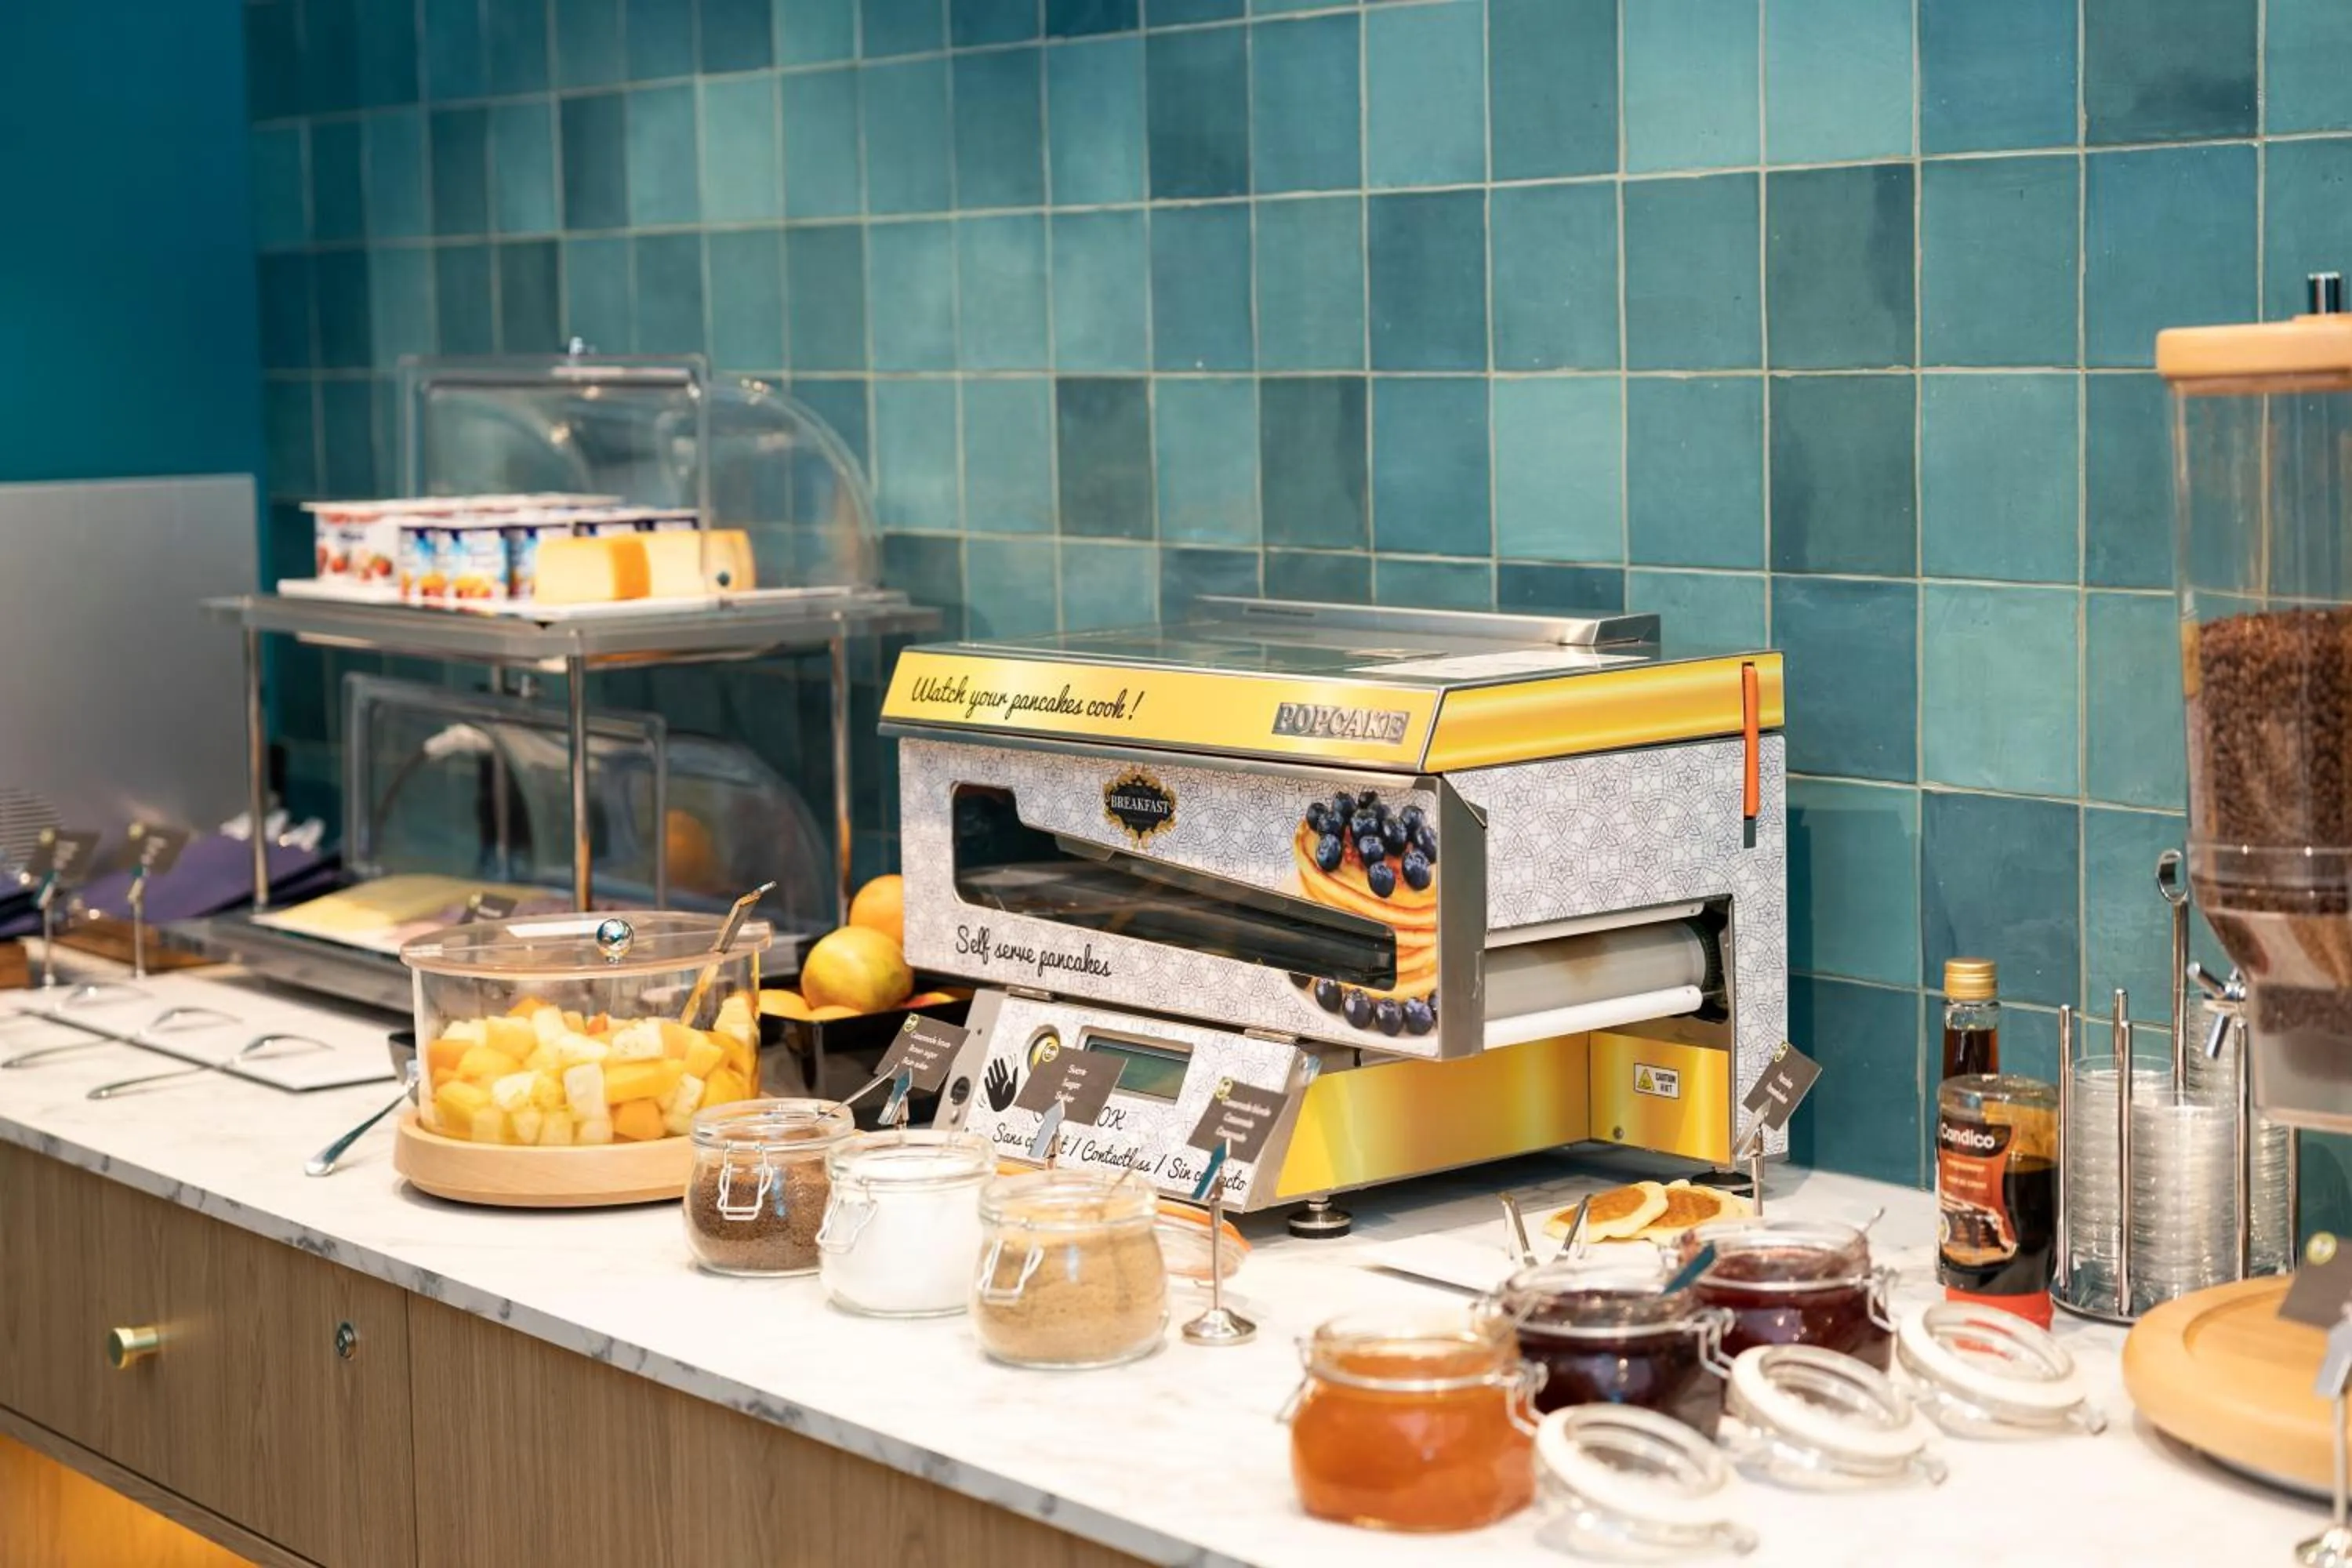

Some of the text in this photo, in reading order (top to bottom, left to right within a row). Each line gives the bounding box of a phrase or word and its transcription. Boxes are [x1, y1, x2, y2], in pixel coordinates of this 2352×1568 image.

[910, 675, 1145, 720] Watch your pancakes cook !
[1278, 703, 1407, 742] POPCAKE
[1110, 794, 1169, 815] BREAKFAST
[956, 924, 1112, 978] Self serve pancakes
[992, 1122, 1023, 1147] Sans
[1167, 1156, 1192, 1180] Sin
[1940, 1122, 1995, 1149] Candico
